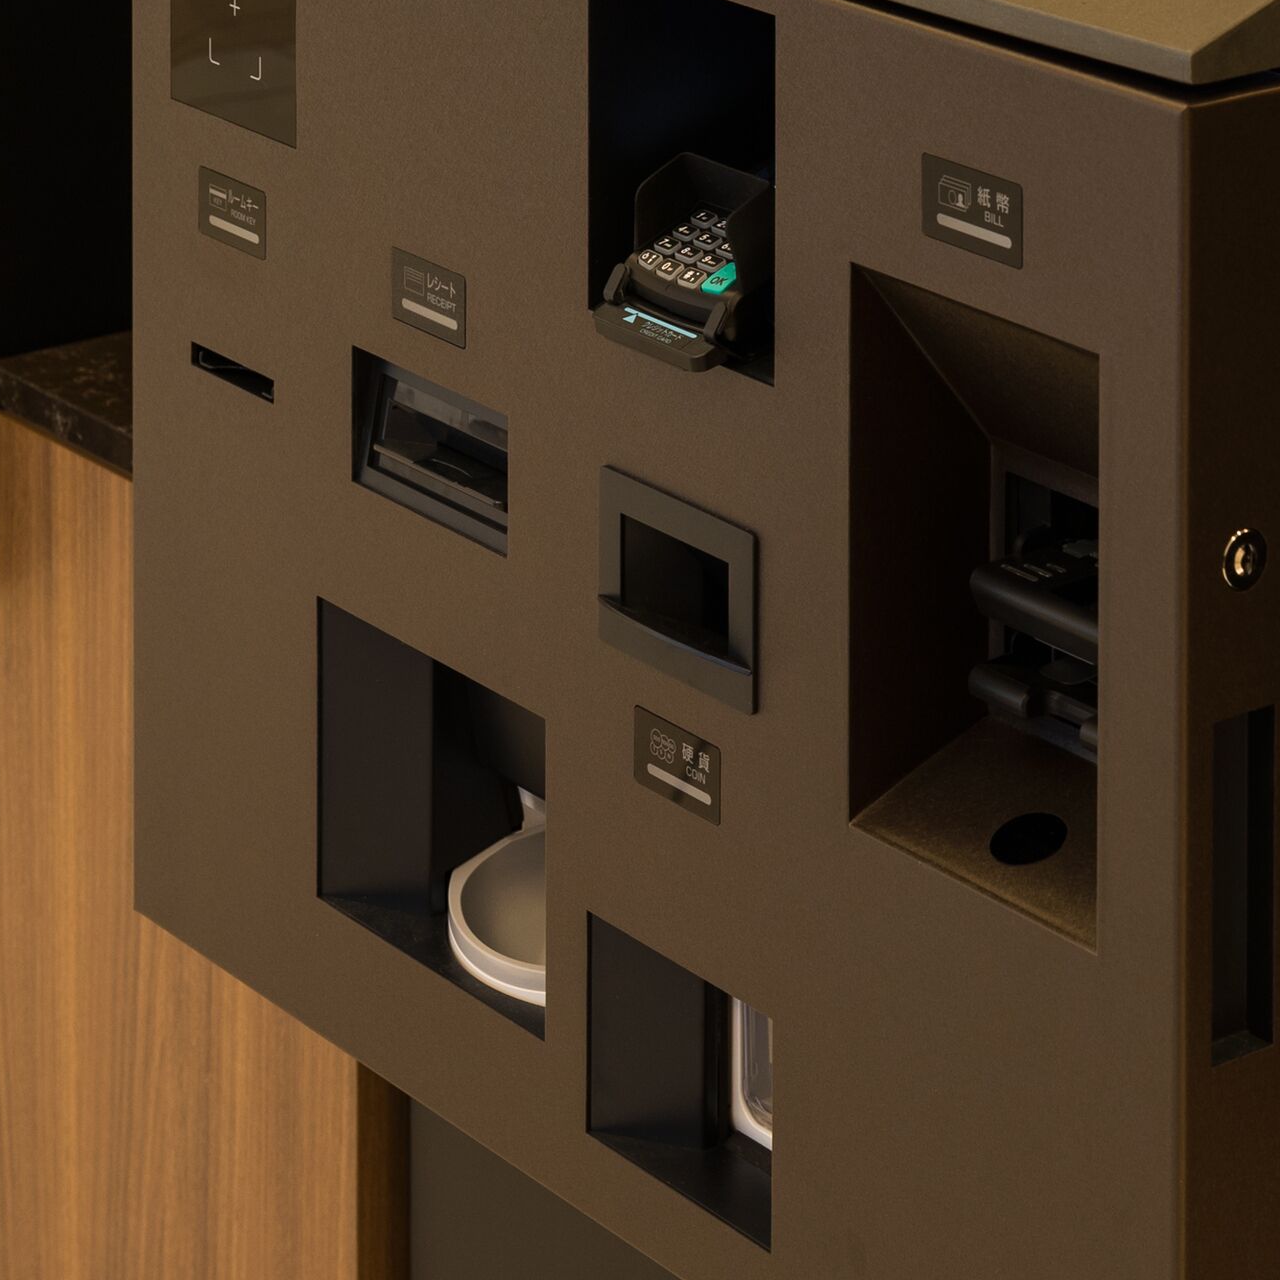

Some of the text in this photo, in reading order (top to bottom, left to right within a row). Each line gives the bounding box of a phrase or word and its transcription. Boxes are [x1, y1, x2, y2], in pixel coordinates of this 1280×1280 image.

[227, 189, 259, 212] ルームキー
[977, 186, 1010, 214] 紙幣
[984, 210, 1004, 228] BILL
[426, 271, 457, 299] レシート
[709, 275, 729, 286] OK
[426, 292, 457, 313] RECEIPT
[681, 742, 711, 773] 硬貨
[685, 765, 706, 785] COIN
